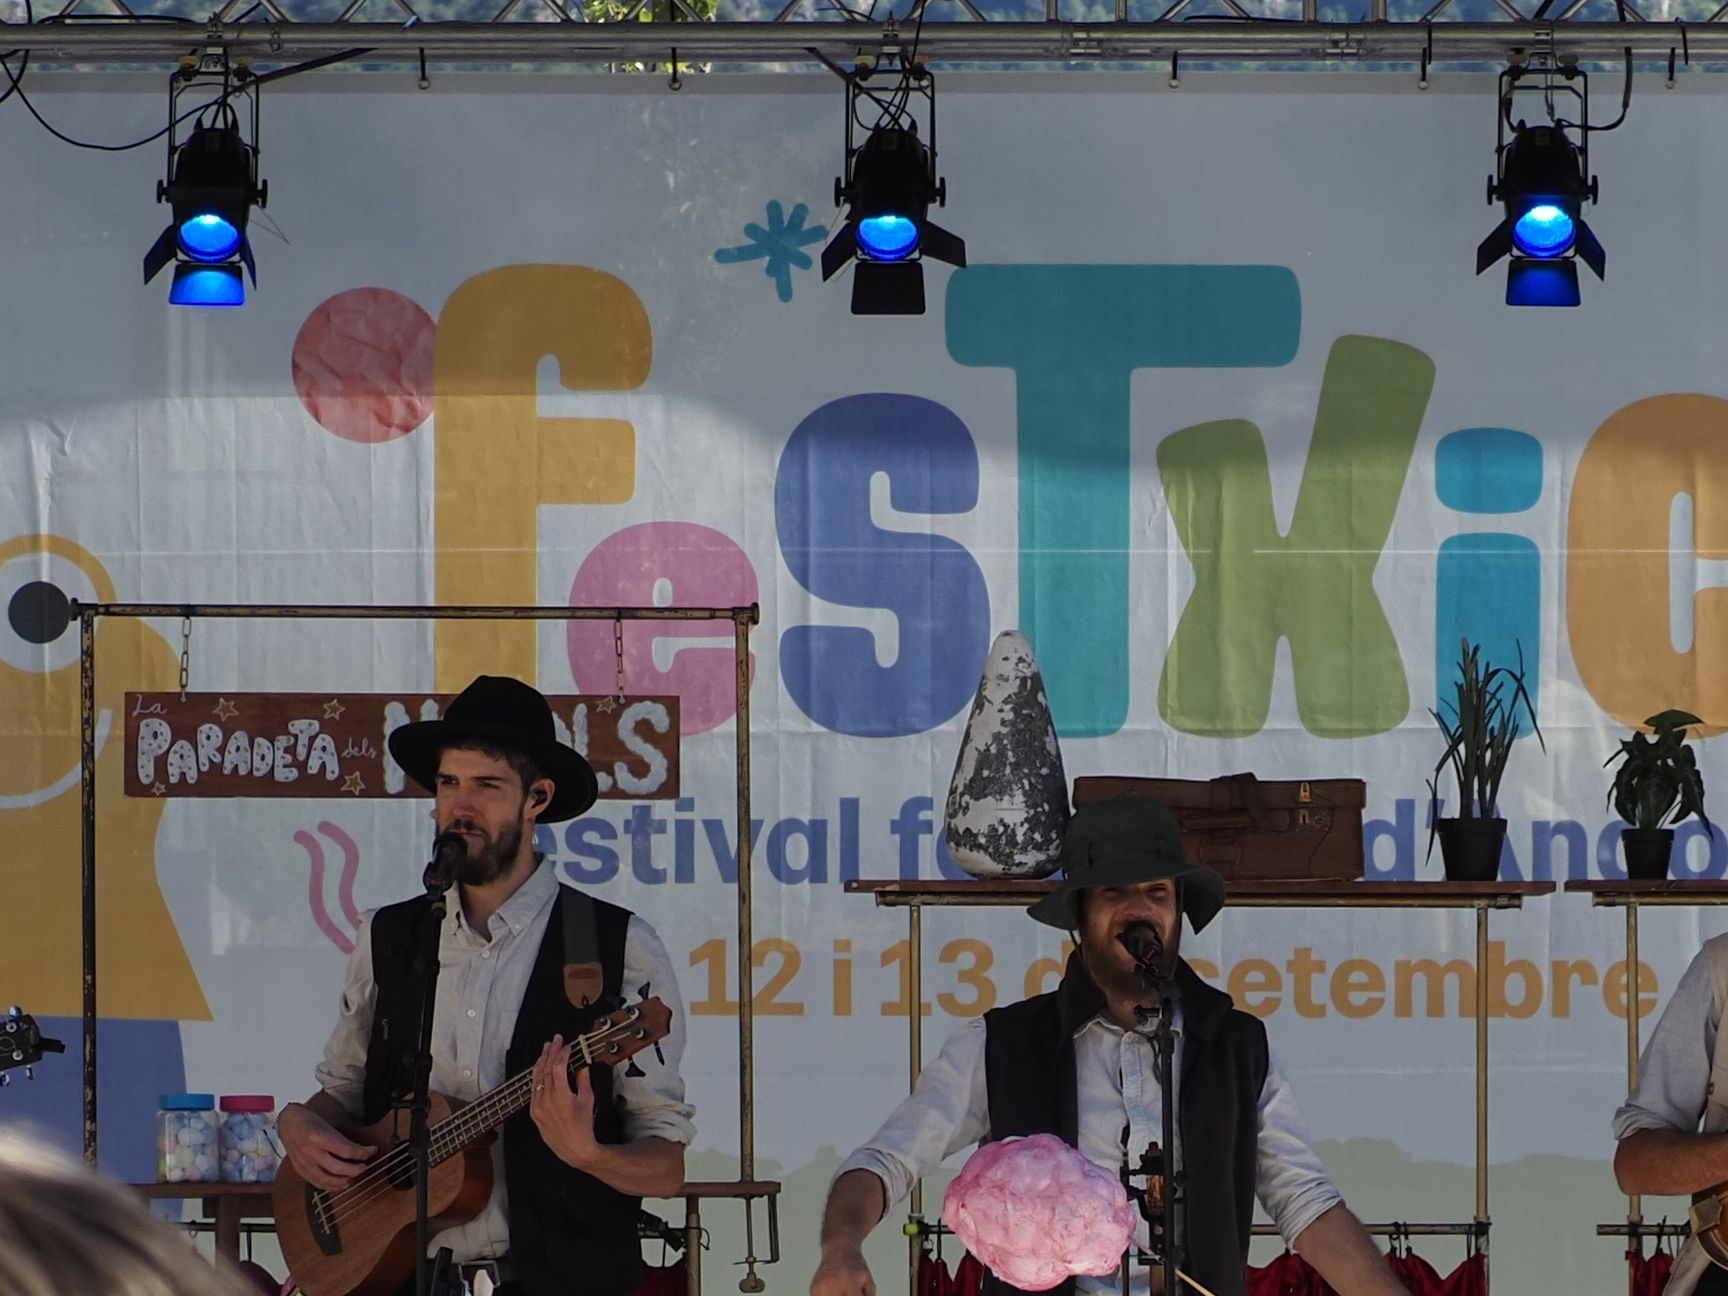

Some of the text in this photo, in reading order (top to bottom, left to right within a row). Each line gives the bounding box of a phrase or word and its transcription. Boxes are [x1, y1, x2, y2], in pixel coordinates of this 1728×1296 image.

[132, 694, 167, 716] La
[341, 736, 377, 759] dels
[688, 937, 805, 1017] 12
[832, 937, 853, 1017] i
[879, 937, 999, 1018] 13
[1023, 938, 1077, 1001] d
